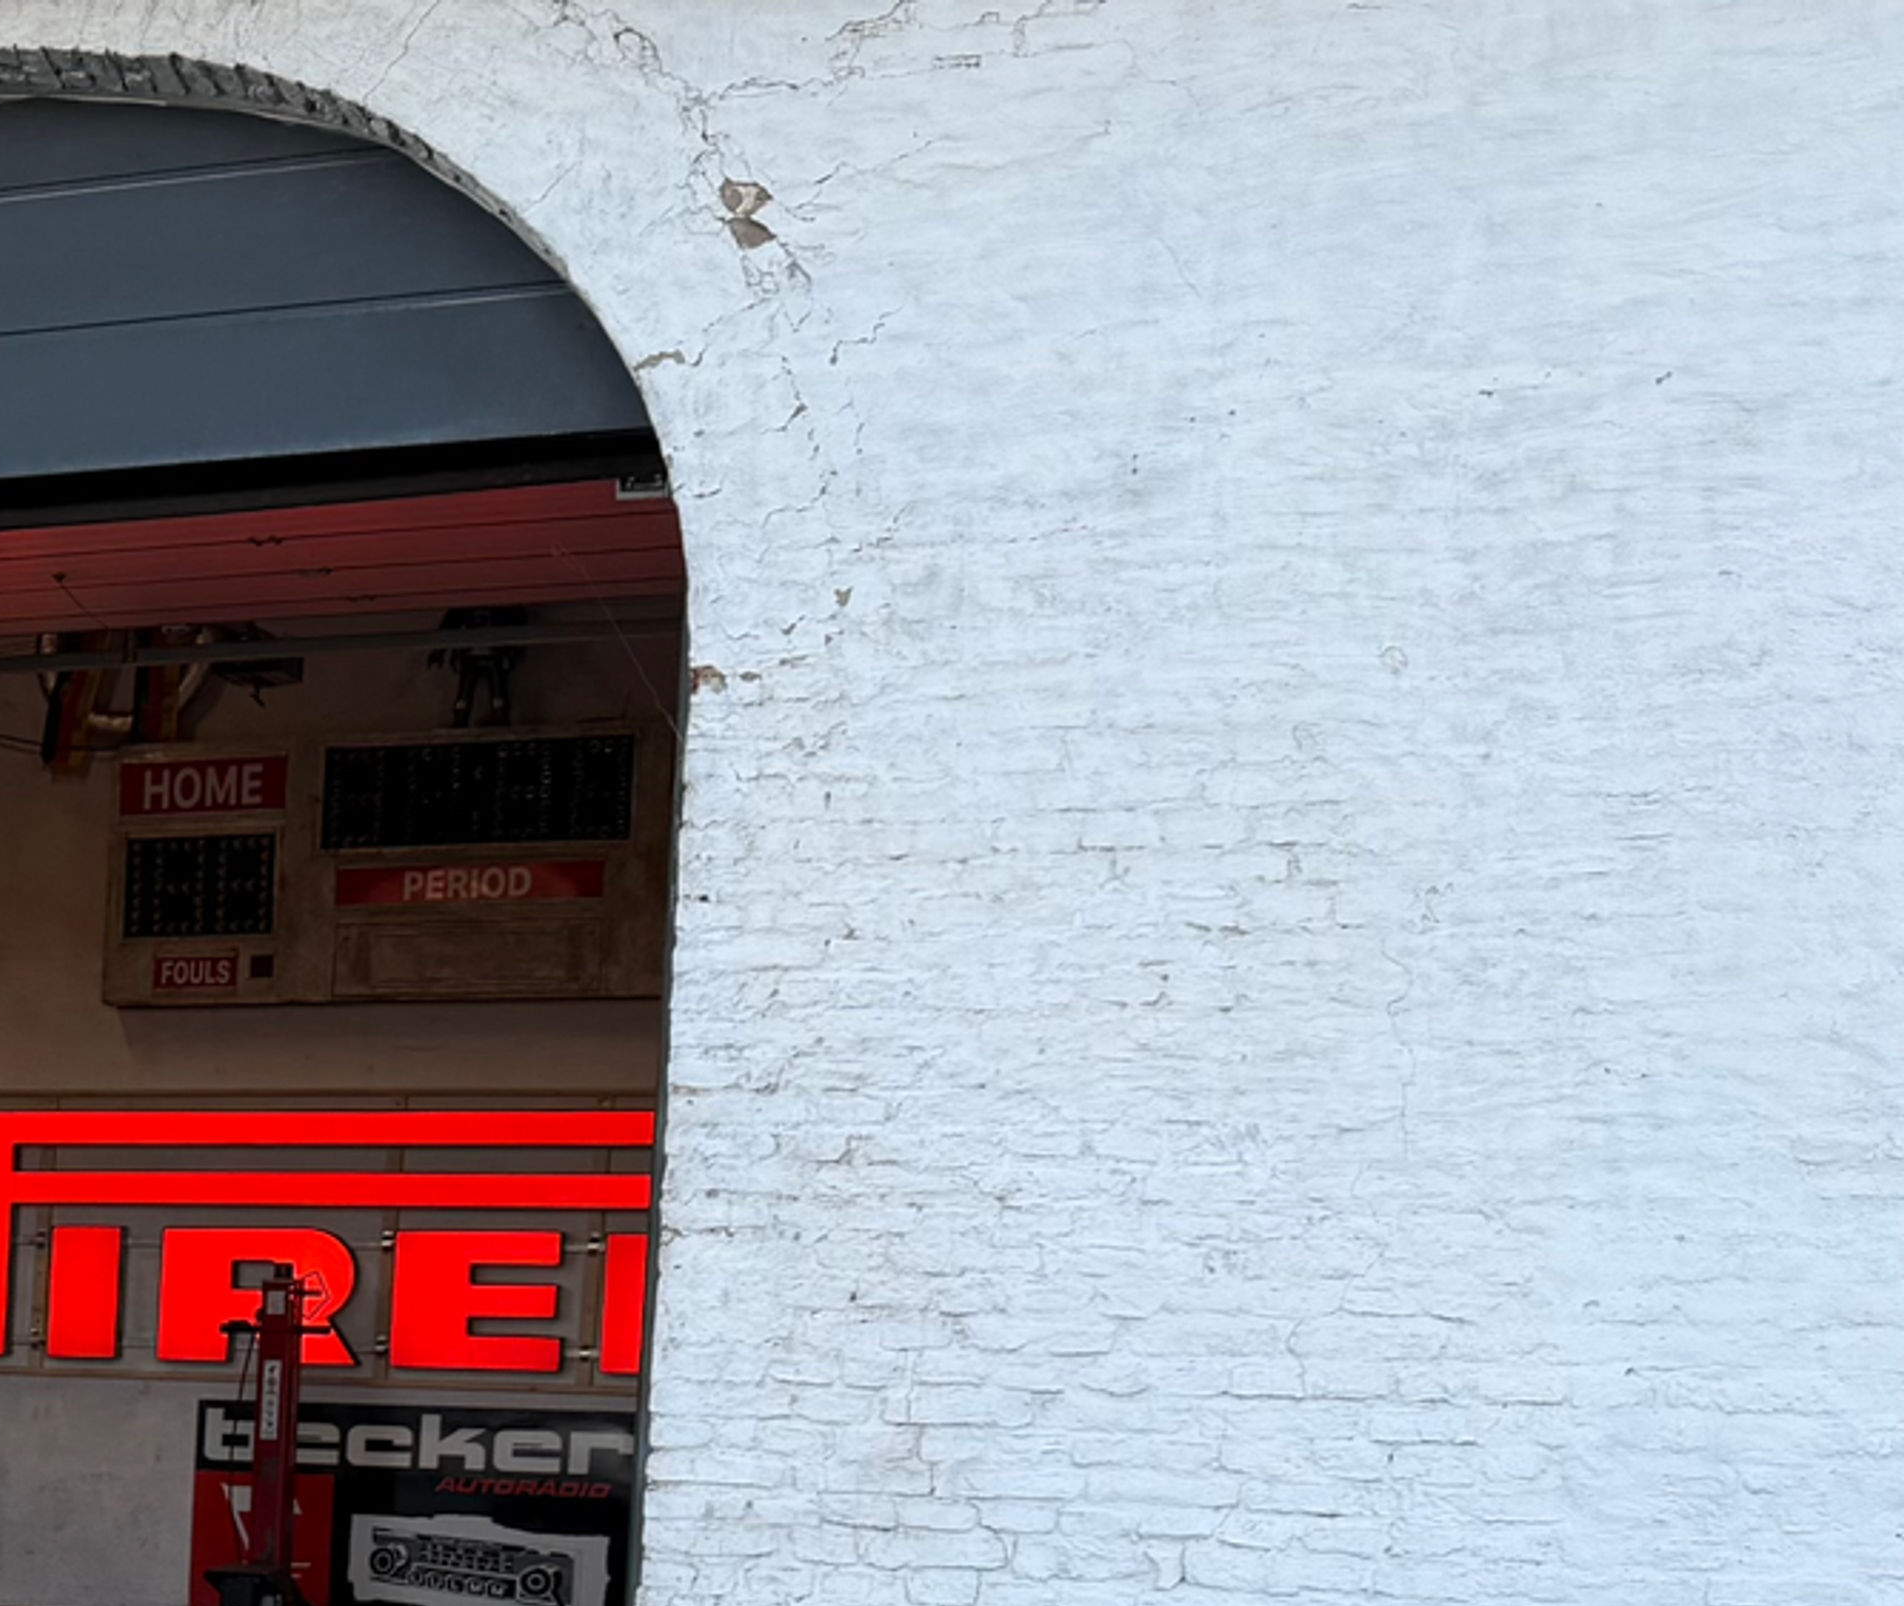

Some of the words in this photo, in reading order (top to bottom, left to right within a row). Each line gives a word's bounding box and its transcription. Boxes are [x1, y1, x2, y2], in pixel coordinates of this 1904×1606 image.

[142, 762, 264, 811] HOME
[402, 864, 533, 902] PERIOD
[159, 958, 233, 986] FOULS
[203, 1407, 636, 1475] becker
[434, 1475, 613, 1499] AUTORADIO
